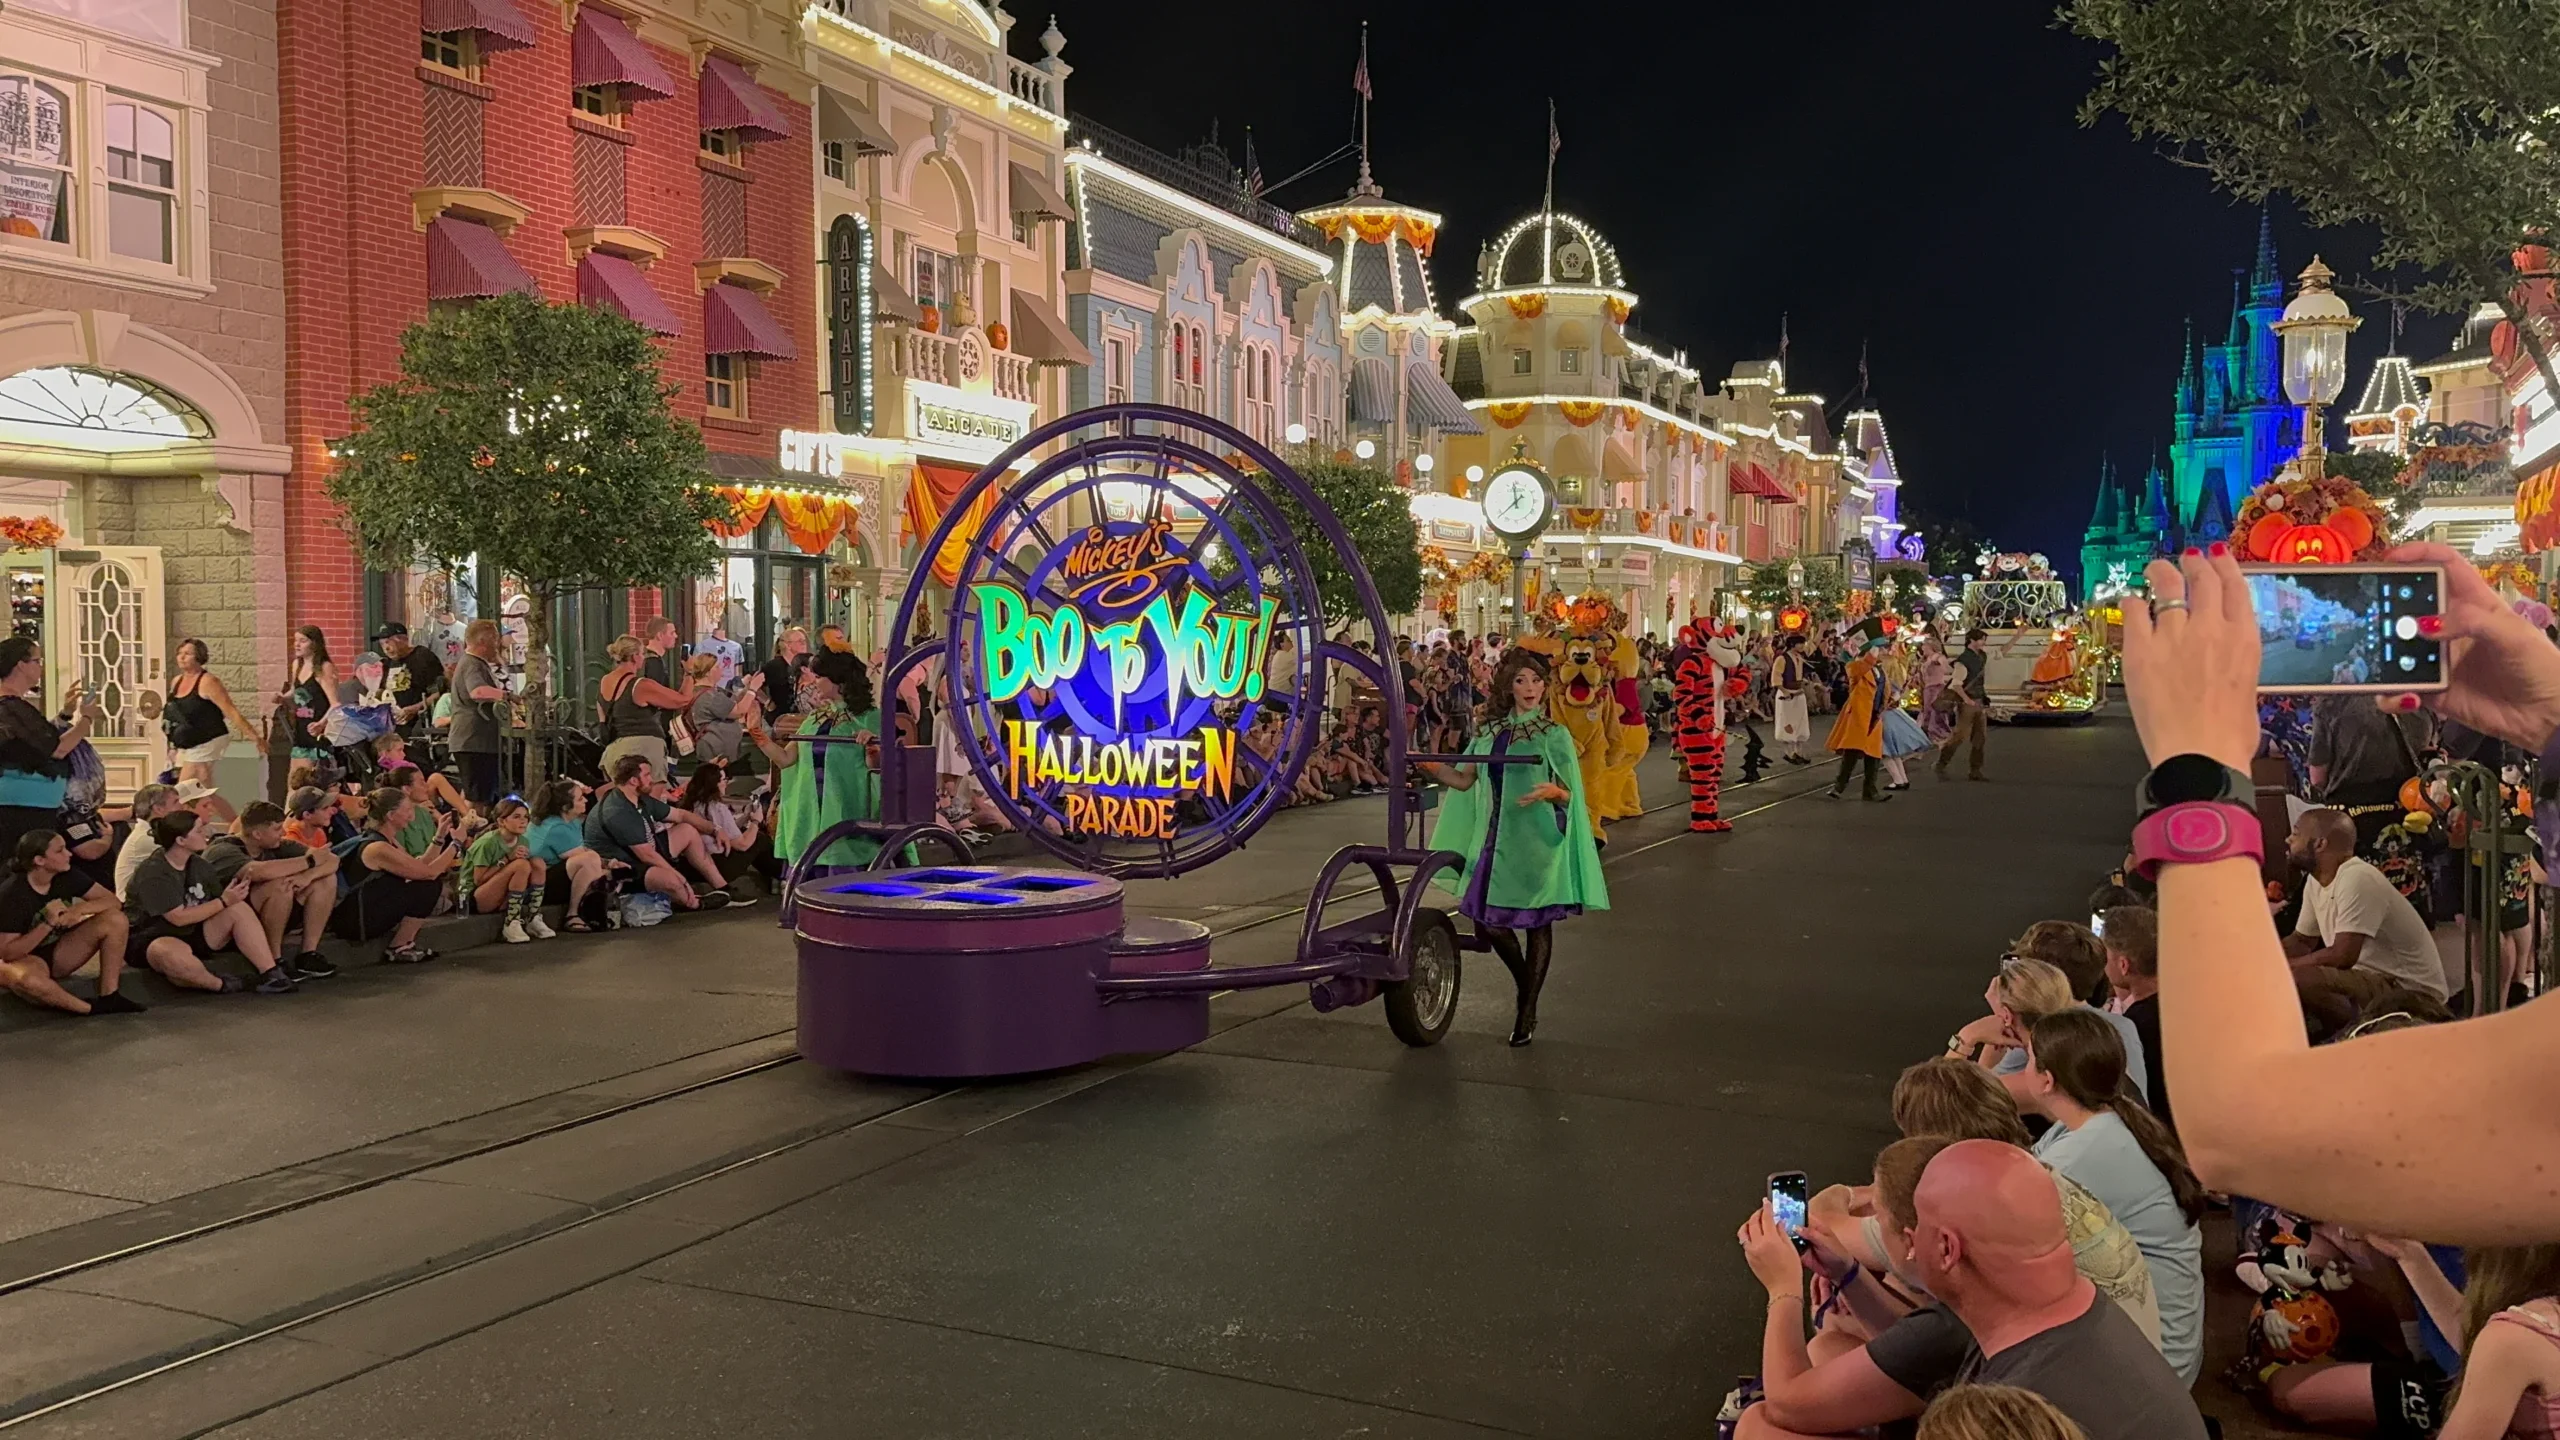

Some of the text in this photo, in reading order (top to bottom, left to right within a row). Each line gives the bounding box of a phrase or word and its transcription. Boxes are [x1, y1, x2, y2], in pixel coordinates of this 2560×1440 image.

[839, 234, 853, 417] ARCADE
[927, 411, 1013, 443] ARCADE
[780, 429, 842, 477] GIFTS
[1109, 505, 1127, 516] TOYS
[966, 580, 1281, 735] BOO TO YOU!
[1004, 720, 1236, 805] HALLOWEEN
[1066, 794, 1178, 840] PARADE
[2348, 803, 2395, 818] Halloween
